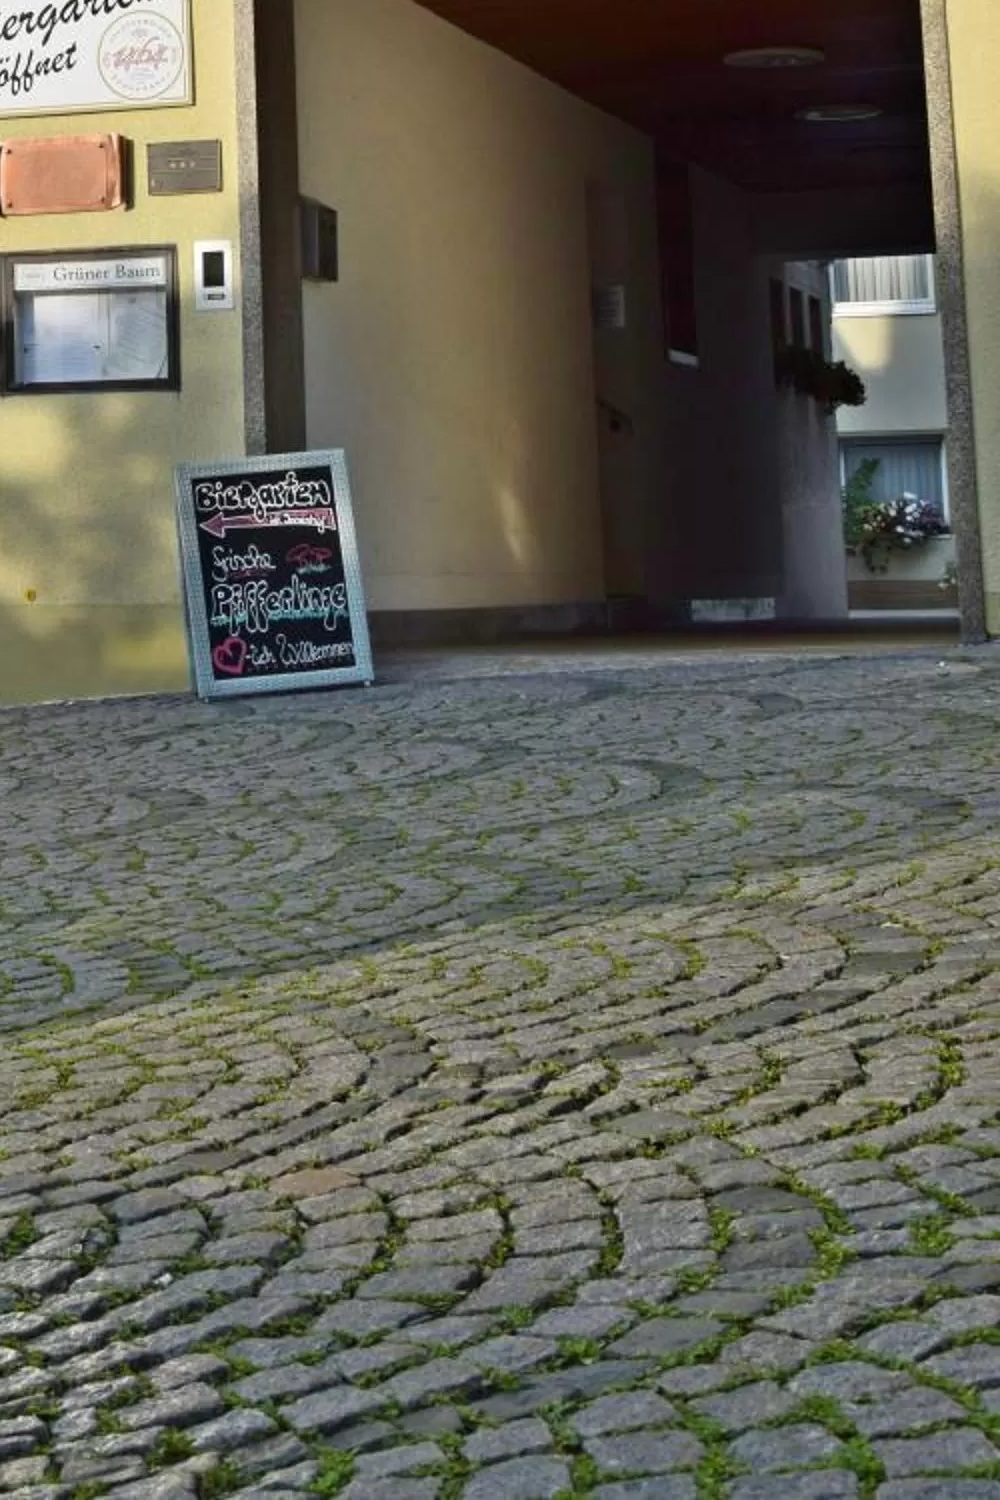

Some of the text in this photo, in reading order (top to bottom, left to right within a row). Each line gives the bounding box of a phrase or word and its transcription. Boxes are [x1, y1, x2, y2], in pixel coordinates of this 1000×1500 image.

[53, 265, 109, 283] Grüner
[115, 263, 161, 279] Baum
[195, 471, 331, 523] Biergarten
